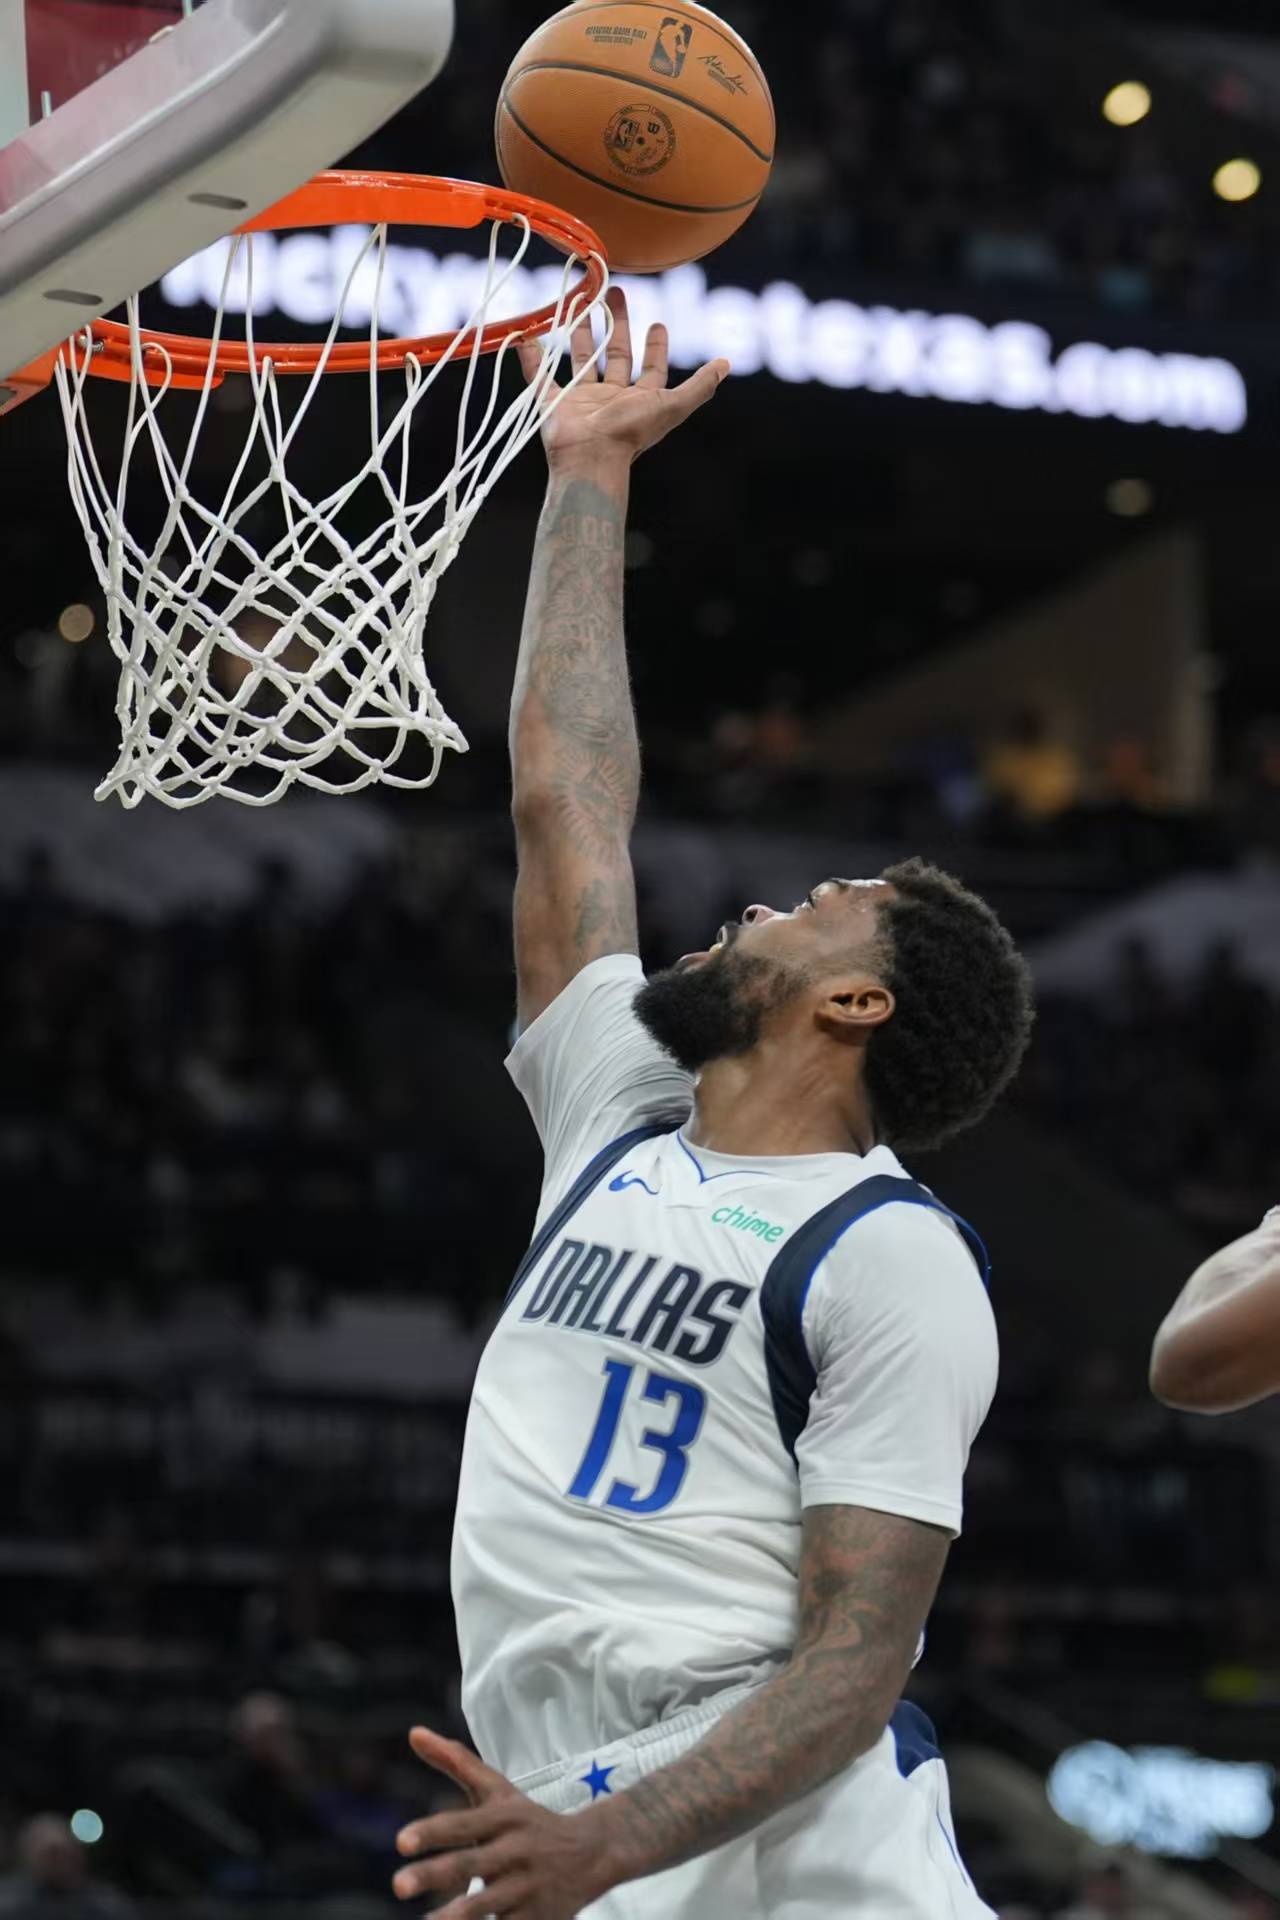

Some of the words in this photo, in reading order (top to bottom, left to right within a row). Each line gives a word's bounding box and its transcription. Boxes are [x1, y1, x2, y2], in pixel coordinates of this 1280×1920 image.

[712, 1205, 785, 1243] chime
[519, 1236, 755, 1368] DALLAS
[566, 1359, 707, 1519] 13
